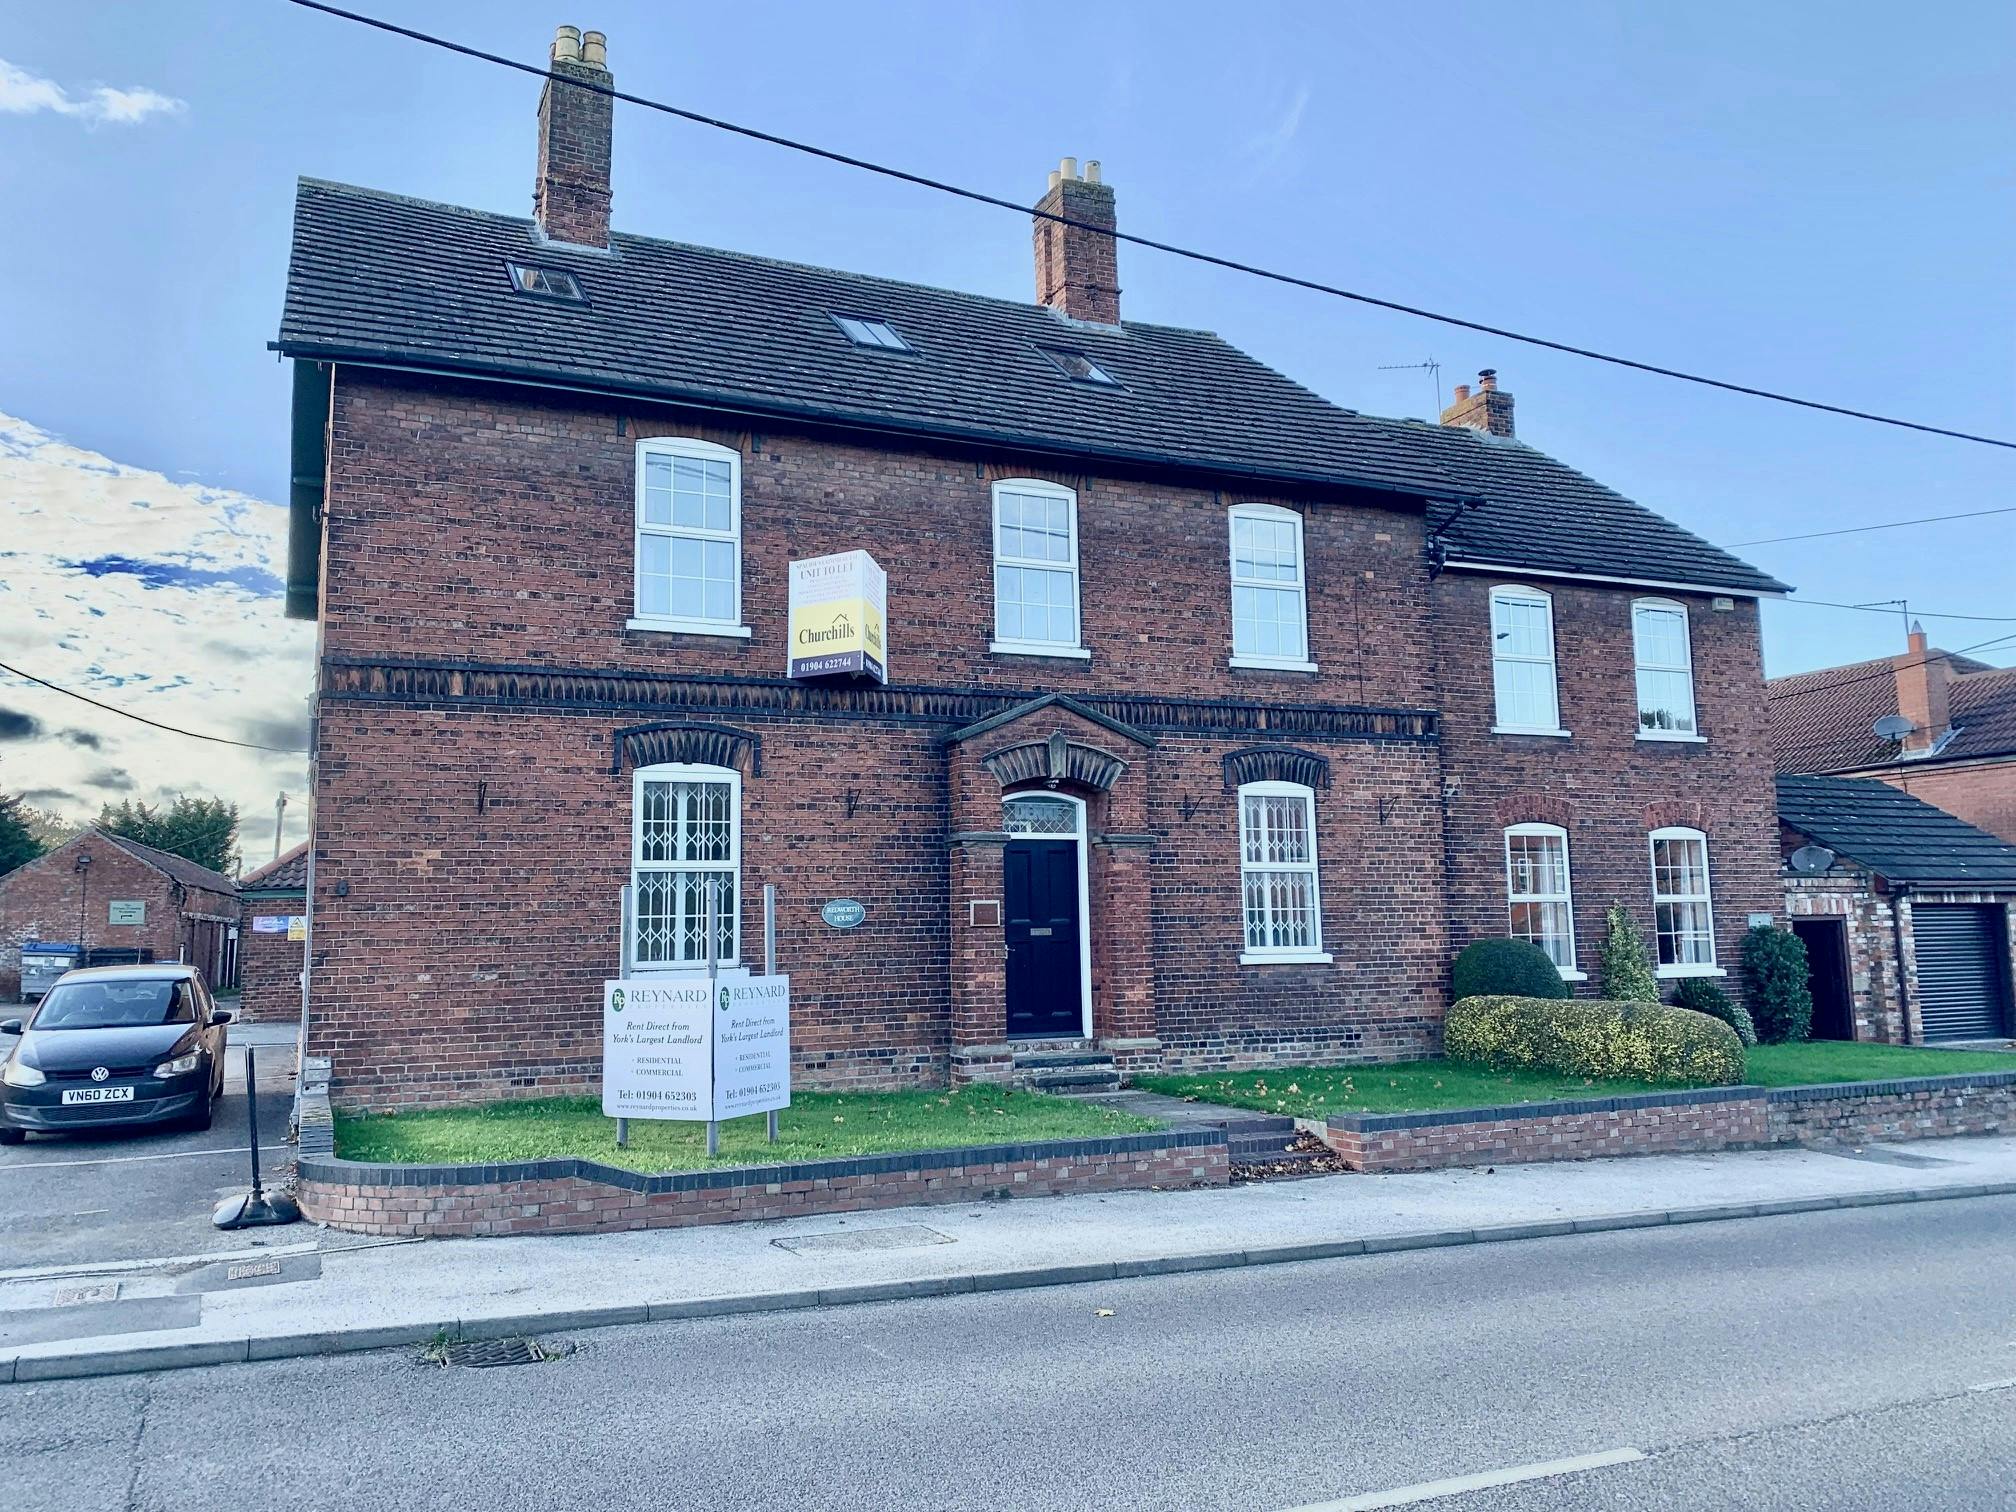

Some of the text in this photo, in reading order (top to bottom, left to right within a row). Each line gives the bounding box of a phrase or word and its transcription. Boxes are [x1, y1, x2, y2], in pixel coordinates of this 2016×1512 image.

[799, 623, 855, 645] Churchills
[800, 660, 823, 672] 01904
[824, 657, 852, 670] 622744
[630, 989, 708, 1003] REYNARD
[733, 985, 786, 1001] REYNARD
[626, 1021, 690, 1031] Rent Direct from
[730, 1017, 776, 1029] Rent Direct from
[612, 1034, 703, 1045] York's Largest Landlord
[720, 1027, 784, 1043] York's Largest Landlord
[636, 1057, 683, 1065] RESIDENTIAL
[68, 1088, 129, 1102] VN60 ZCX
[617, 1089, 697, 1101] Tel: 01904 652303
[725, 1081, 781, 1100] Tel: 01904 652303
